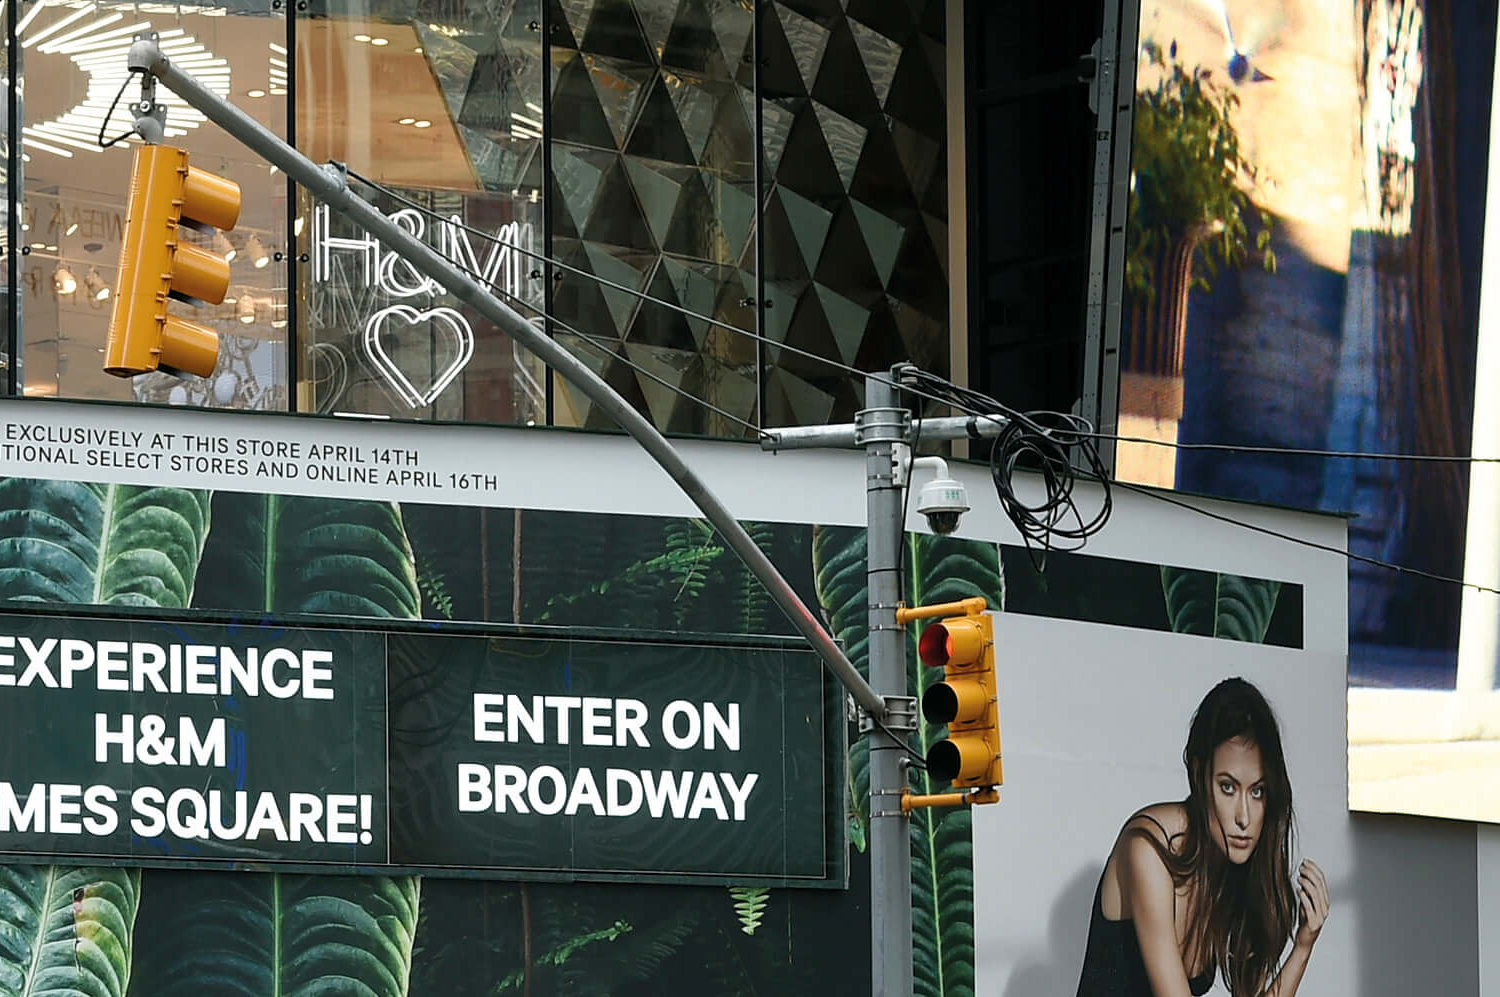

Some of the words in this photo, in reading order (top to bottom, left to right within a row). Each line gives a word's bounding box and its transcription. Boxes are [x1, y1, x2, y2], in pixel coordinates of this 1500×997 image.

[7, 424, 143, 448] EXCLUSIVELY
[150, 434, 176, 450] AT
[182, 436, 229, 454] THIS
[236, 439, 301, 459] STORE
[308, 445, 365, 464] APRIL
[371, 449, 419, 467] 14TH
[87, 450, 162, 470] SELECT
[170, 455, 249, 476] STORES
[256, 461, 299, 479] AND
[306, 464, 379, 485] ONLINE
[386, 470, 443, 489] APRIL
[449, 474, 498, 491] 16TH
[94, 713, 227, 768] H&M
[473, 693, 651, 748] ENTER
[661, 700, 741, 752] ON
[130, 786, 373, 846] SQUARE!
[457, 763, 760, 822] BROADWAY
